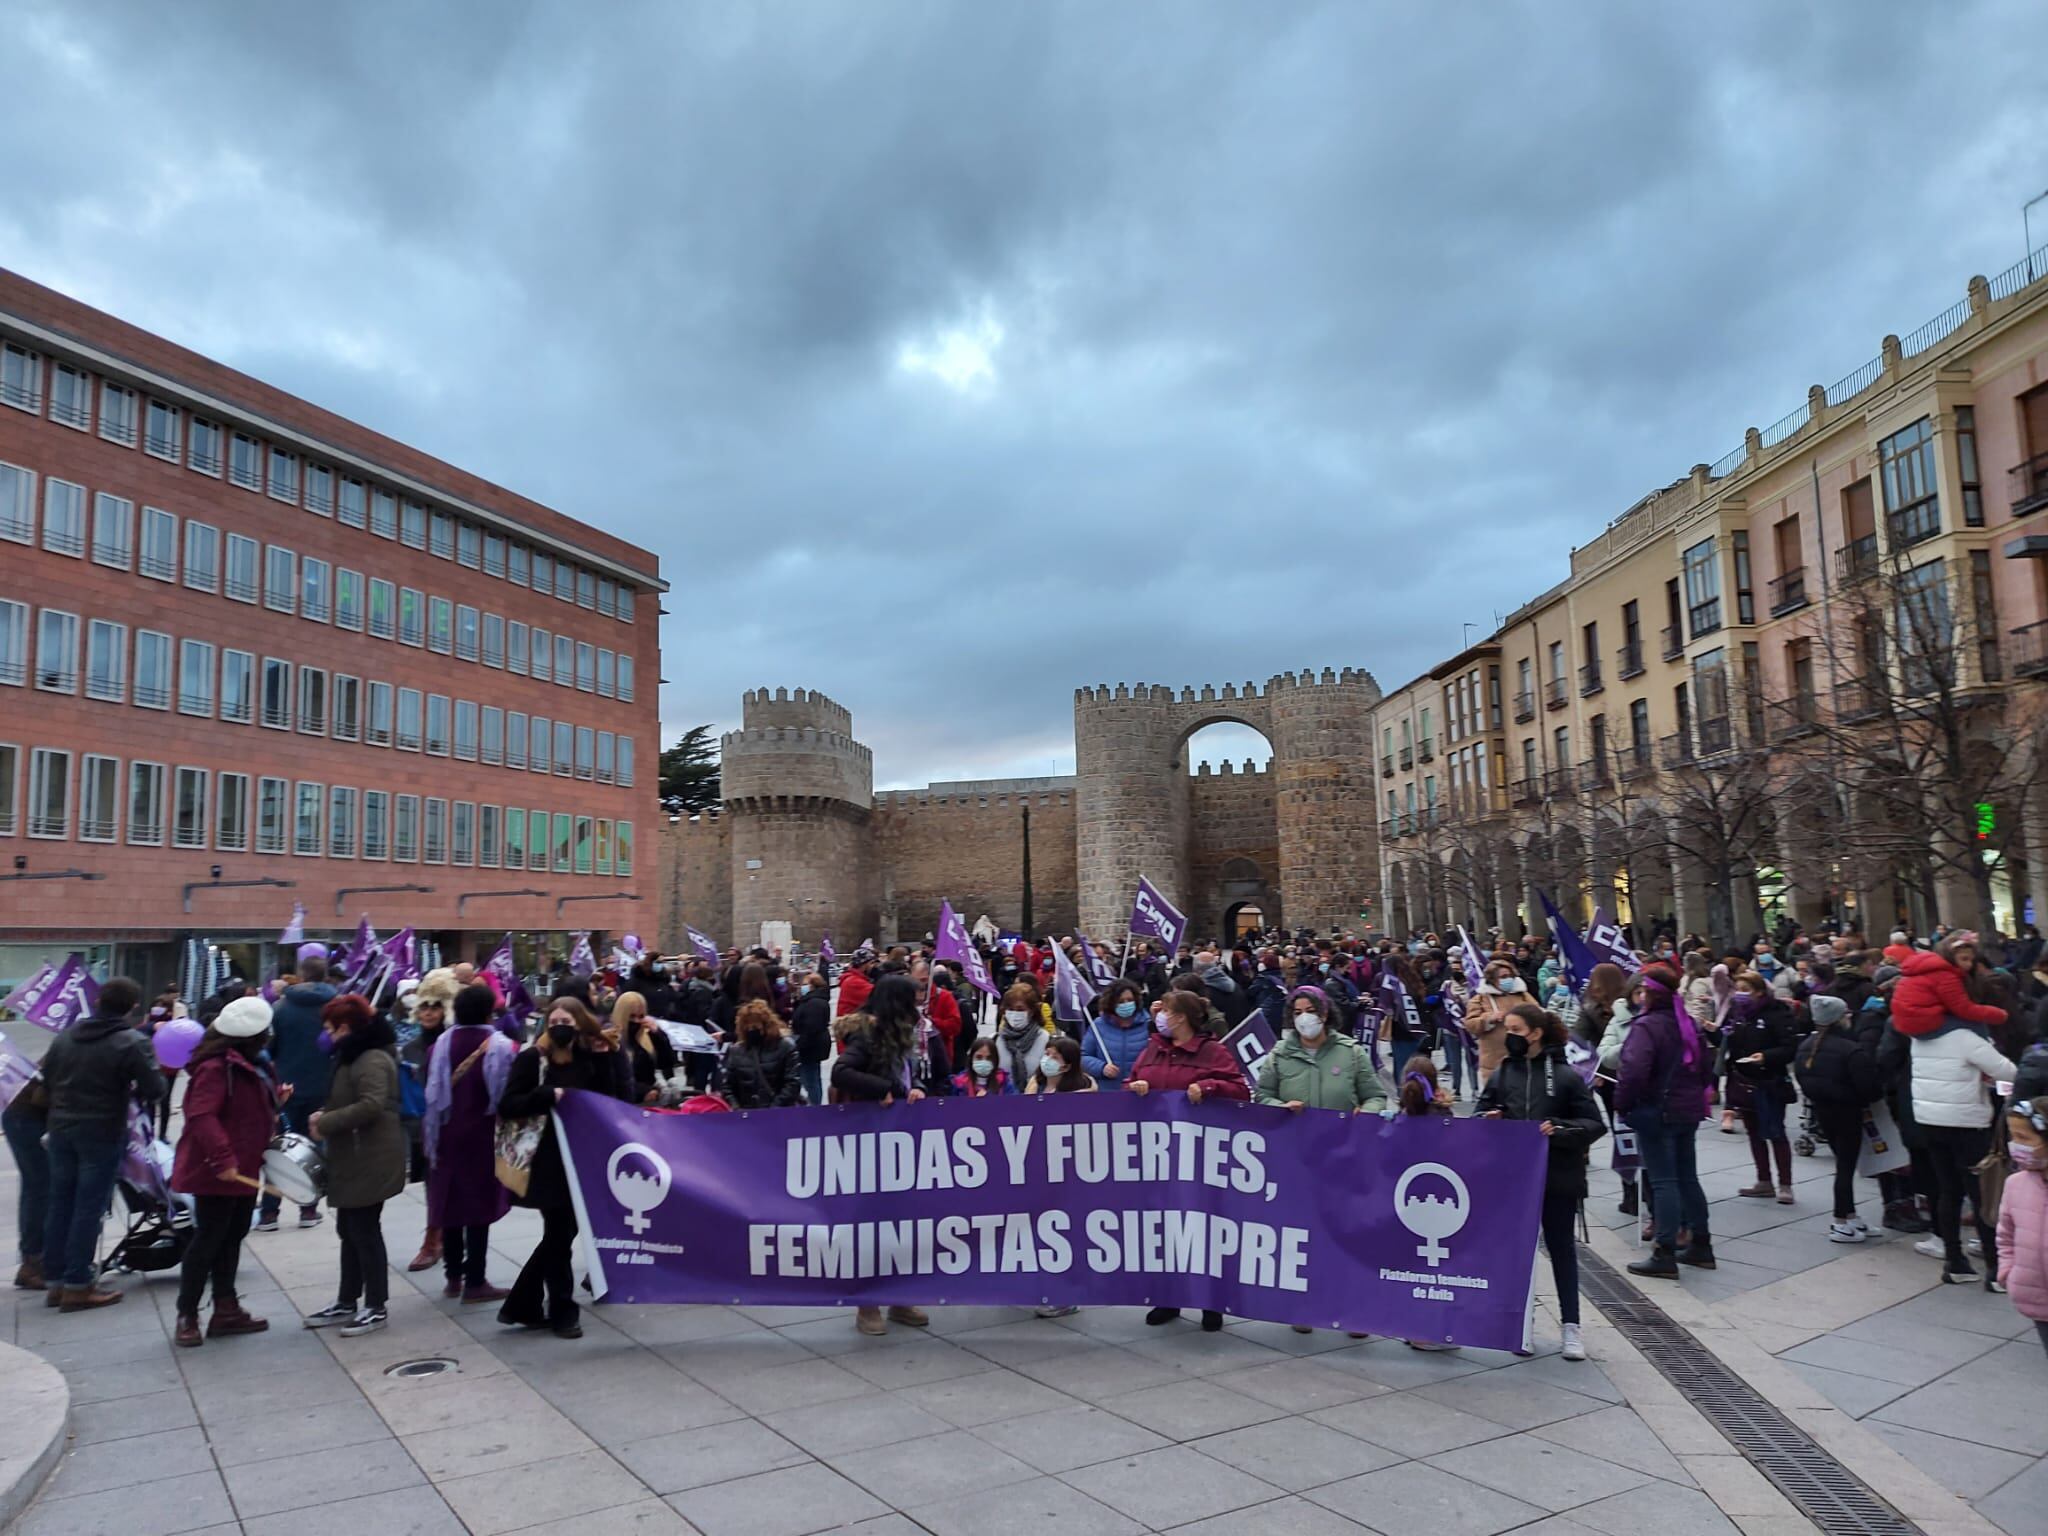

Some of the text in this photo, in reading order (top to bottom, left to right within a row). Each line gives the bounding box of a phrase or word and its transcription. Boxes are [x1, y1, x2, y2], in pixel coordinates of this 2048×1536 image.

[786, 1121, 1278, 1202] UNIDAS Y FUERTES,
[593, 1237, 640, 1250] lataforma
[748, 1209, 1309, 1292] FEMINISTAS SIEMPRE
[616, 1252, 629, 1264] de
[1379, 1268, 1489, 1289] Plataforma feminista
[1412, 1286, 1455, 1301] de Ávila
